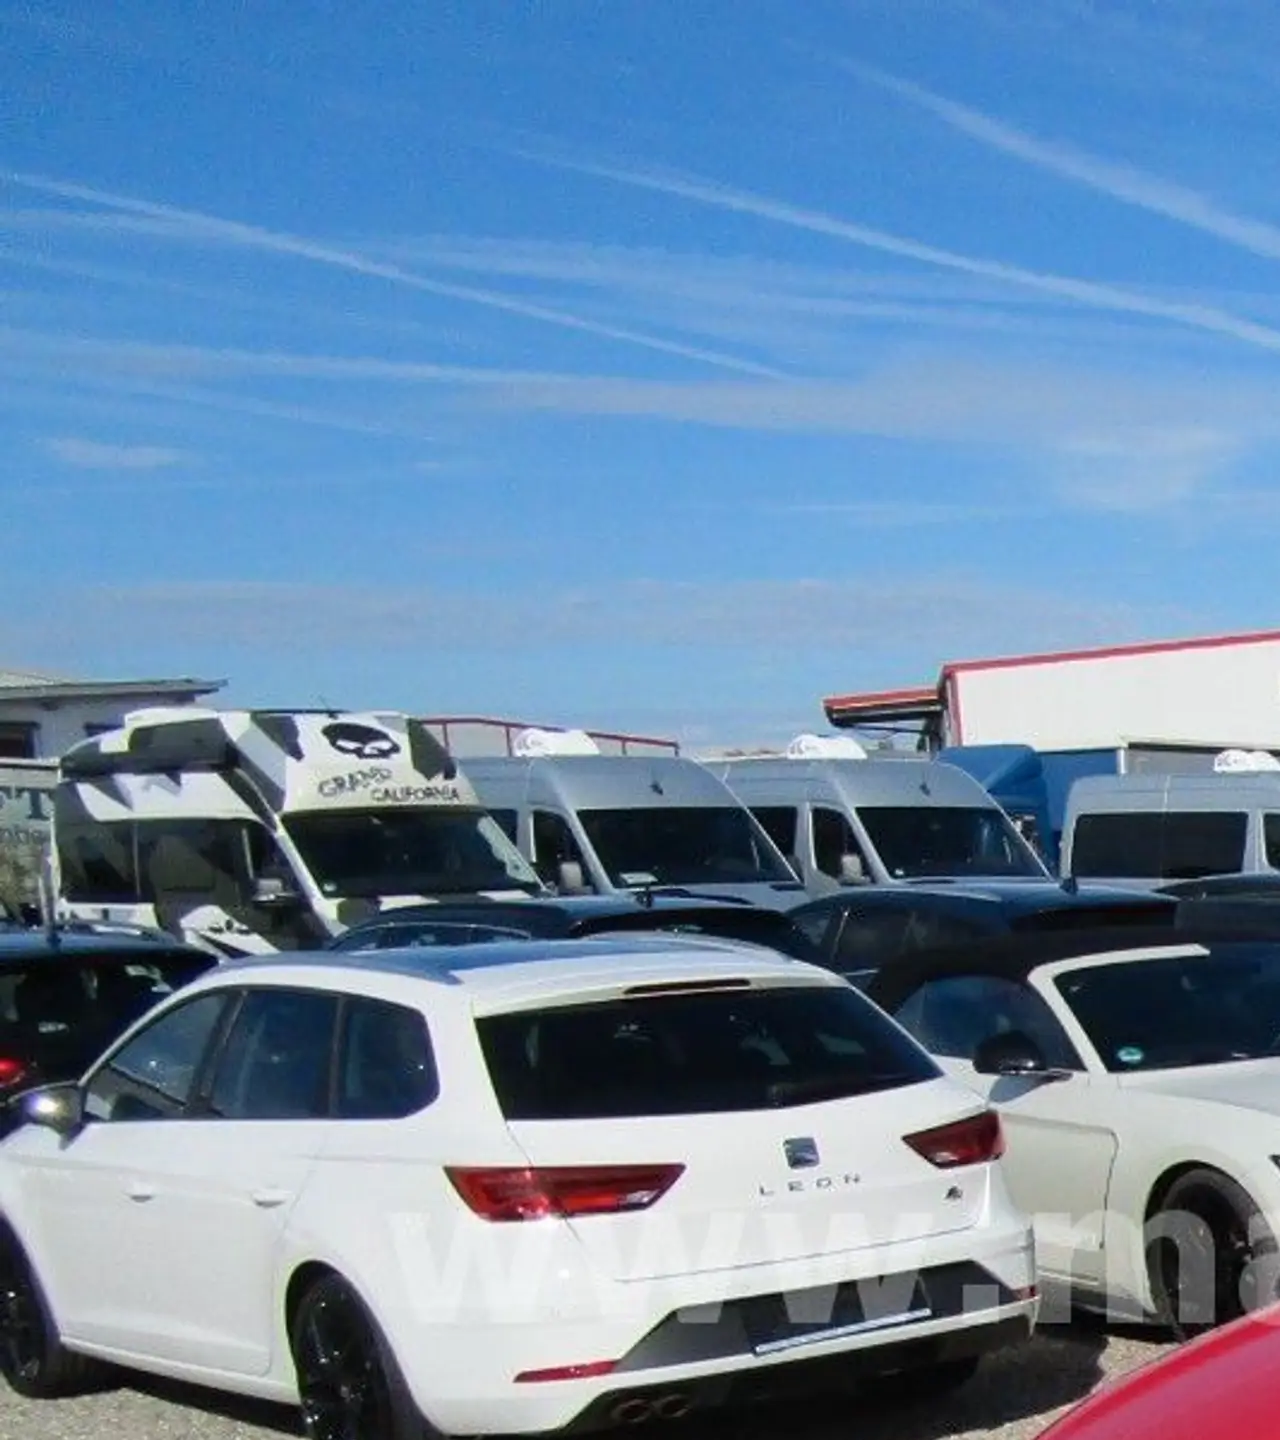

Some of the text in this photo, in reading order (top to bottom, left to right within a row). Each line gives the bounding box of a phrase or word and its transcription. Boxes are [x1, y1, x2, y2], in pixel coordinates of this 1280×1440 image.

[318, 765, 392, 798] GRAND
[370, 786, 460, 802] CALIFORNIA
[759, 1173, 861, 1196] LEON
